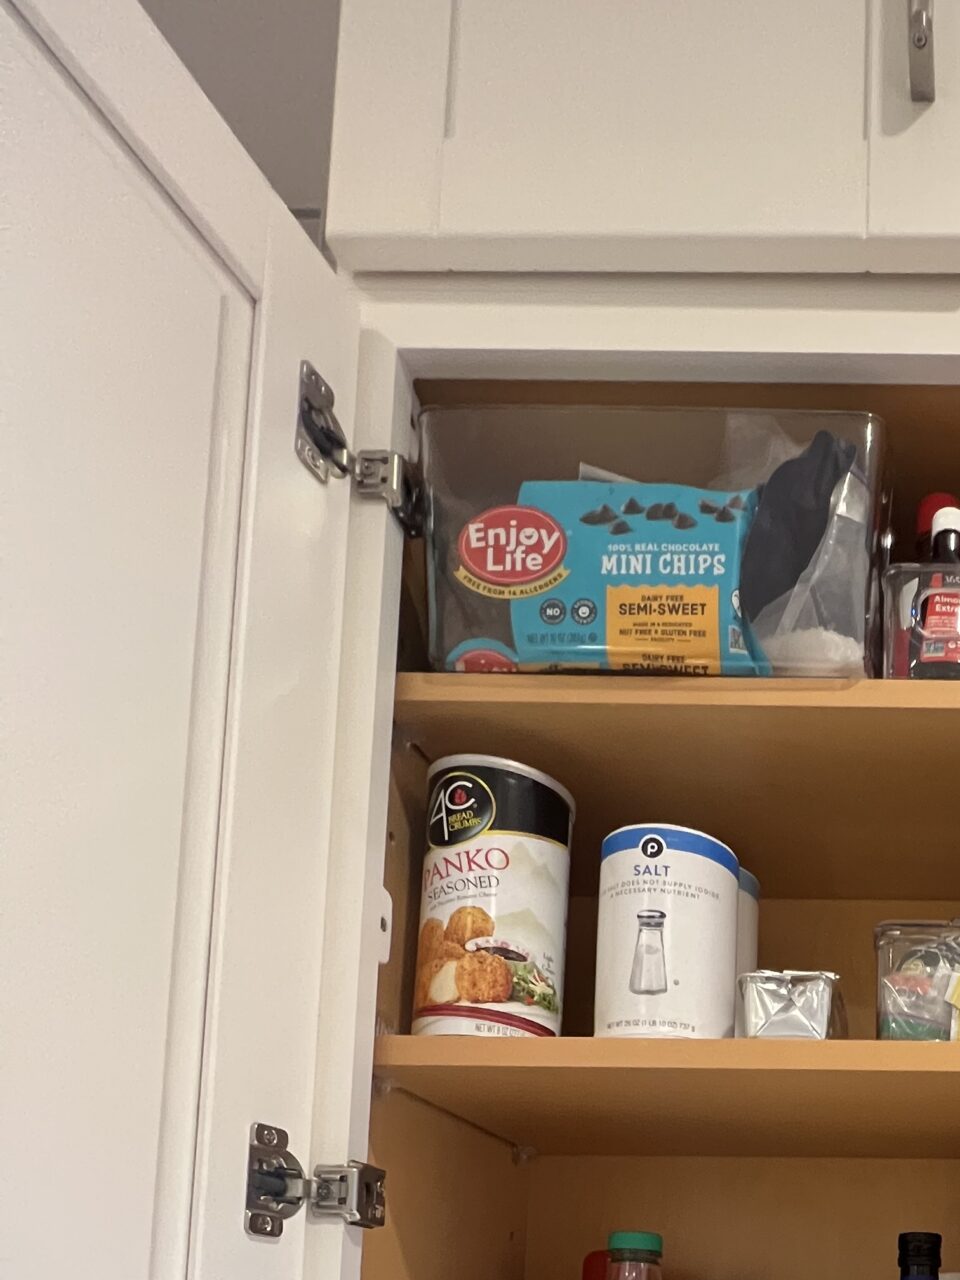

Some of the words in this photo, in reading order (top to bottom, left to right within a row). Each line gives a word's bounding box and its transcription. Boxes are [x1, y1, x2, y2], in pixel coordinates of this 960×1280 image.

[468, 520, 560, 554] Enjoy
[608, 543, 633, 552] 100%
[634, 543, 659, 552] REAL
[661, 543, 720, 552] CHOCOLATE
[487, 546, 543, 571] Life
[601, 554, 652, 575] MINI
[658, 553, 726, 576] CHIPS
[482, 586, 505, 596] FROM
[519, 573, 563, 595] ALLERGENS
[546, 607, 560, 615] NO
[635, 629, 652, 637] FREE
[661, 629, 688, 637] GLUTEN
[689, 630, 706, 638] FREE
[430, 780, 476, 841] 4C
[449, 811, 473, 825] BREAD
[449, 817, 482, 832] CRUMBS
[423, 847, 510, 892] PANKO
[633, 865, 670, 877] SALT
[428, 875, 500, 901] SEASONED
[621, 879, 640, 887] DOES
[662, 880, 692, 890] SUPPLY
[615, 888, 657, 897] NECESSARY
[661, 888, 700, 899] NUTRIENT
[475, 1022, 486, 1032] NET
[486, 1024, 496, 1034] WT
